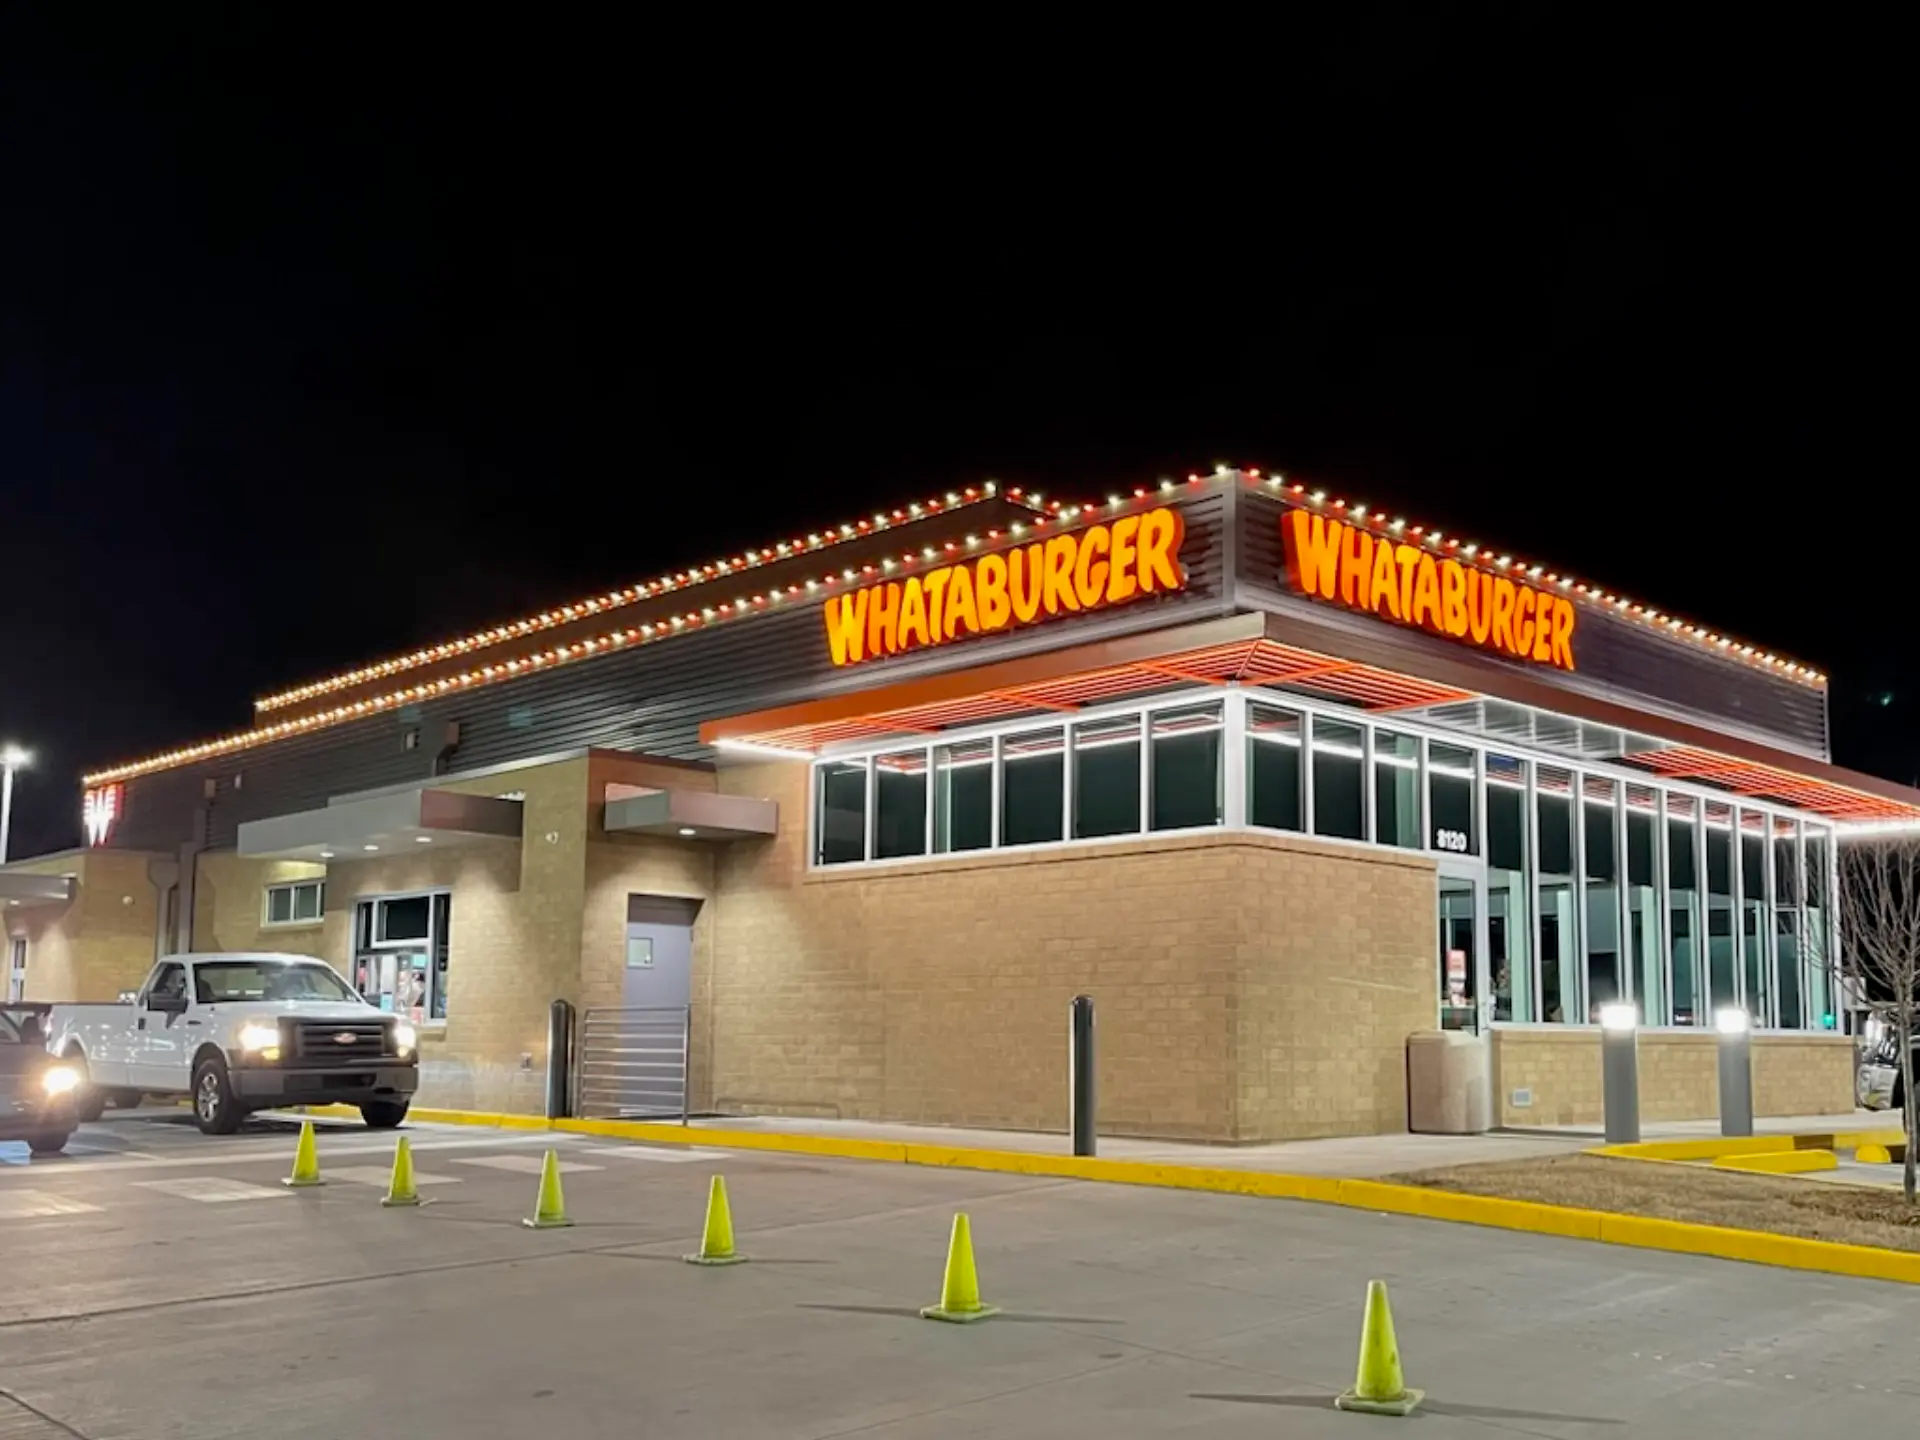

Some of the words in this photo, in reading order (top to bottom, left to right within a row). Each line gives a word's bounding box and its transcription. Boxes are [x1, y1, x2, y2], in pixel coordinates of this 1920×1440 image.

[824, 507, 1180, 666] WHATABURGER
[1290, 509, 1576, 671] WHATABURGER
[83, 784, 117, 848] W
